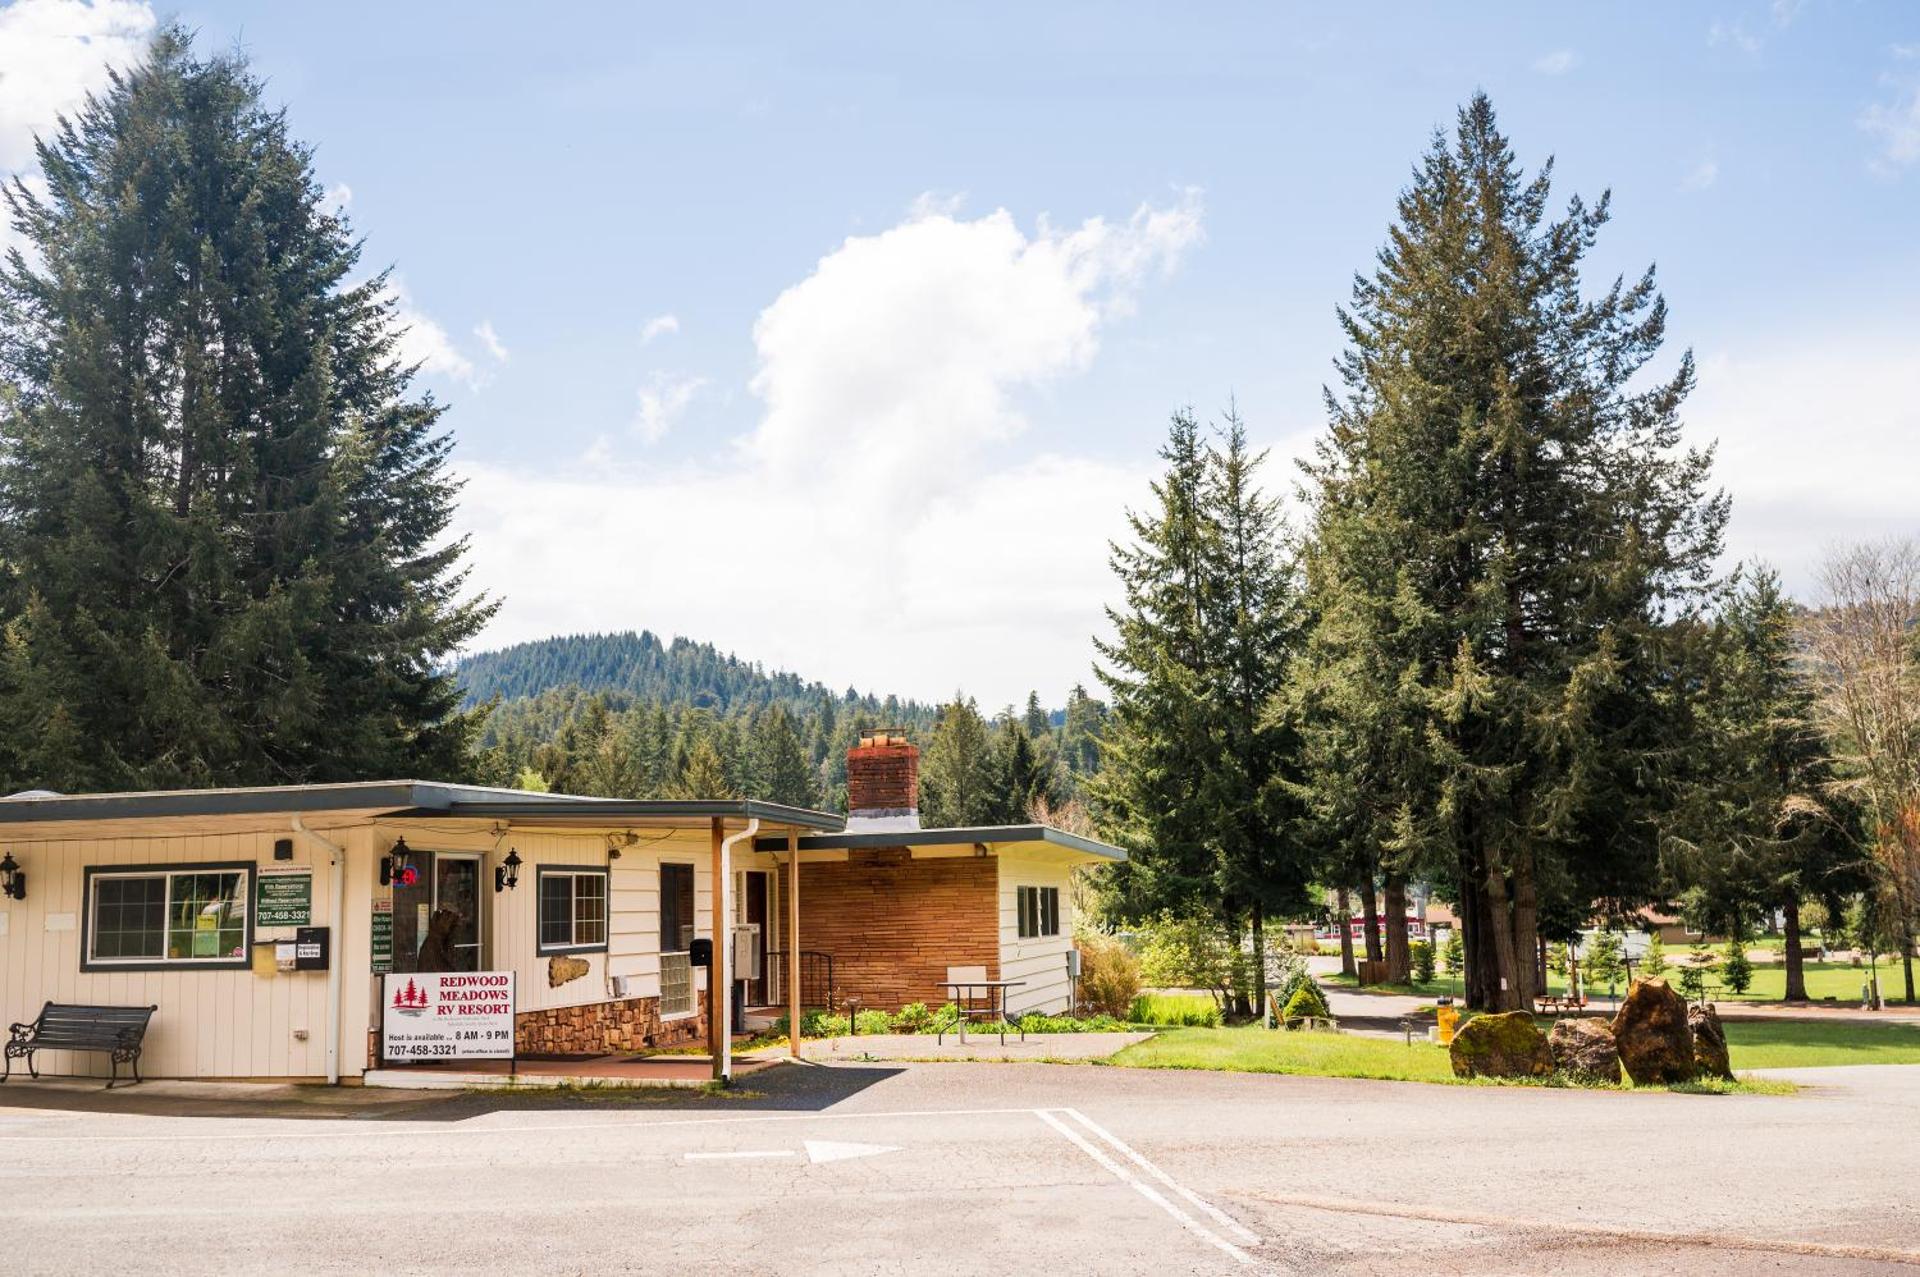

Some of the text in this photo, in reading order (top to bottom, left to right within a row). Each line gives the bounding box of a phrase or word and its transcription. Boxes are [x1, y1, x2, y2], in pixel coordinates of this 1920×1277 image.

[439, 975, 509, 987] REDWOOD
[439, 990, 508, 1001] MEADOWS
[437, 1004, 510, 1015] RV RESORT
[414, 1033, 445, 1041] available
[455, 1030, 461, 1040] 8
[464, 1030, 478, 1039] AM
[486, 1030, 492, 1039] 9
[494, 1030, 509, 1039] PM
[388, 1044, 457, 1055] 707-458-3321
